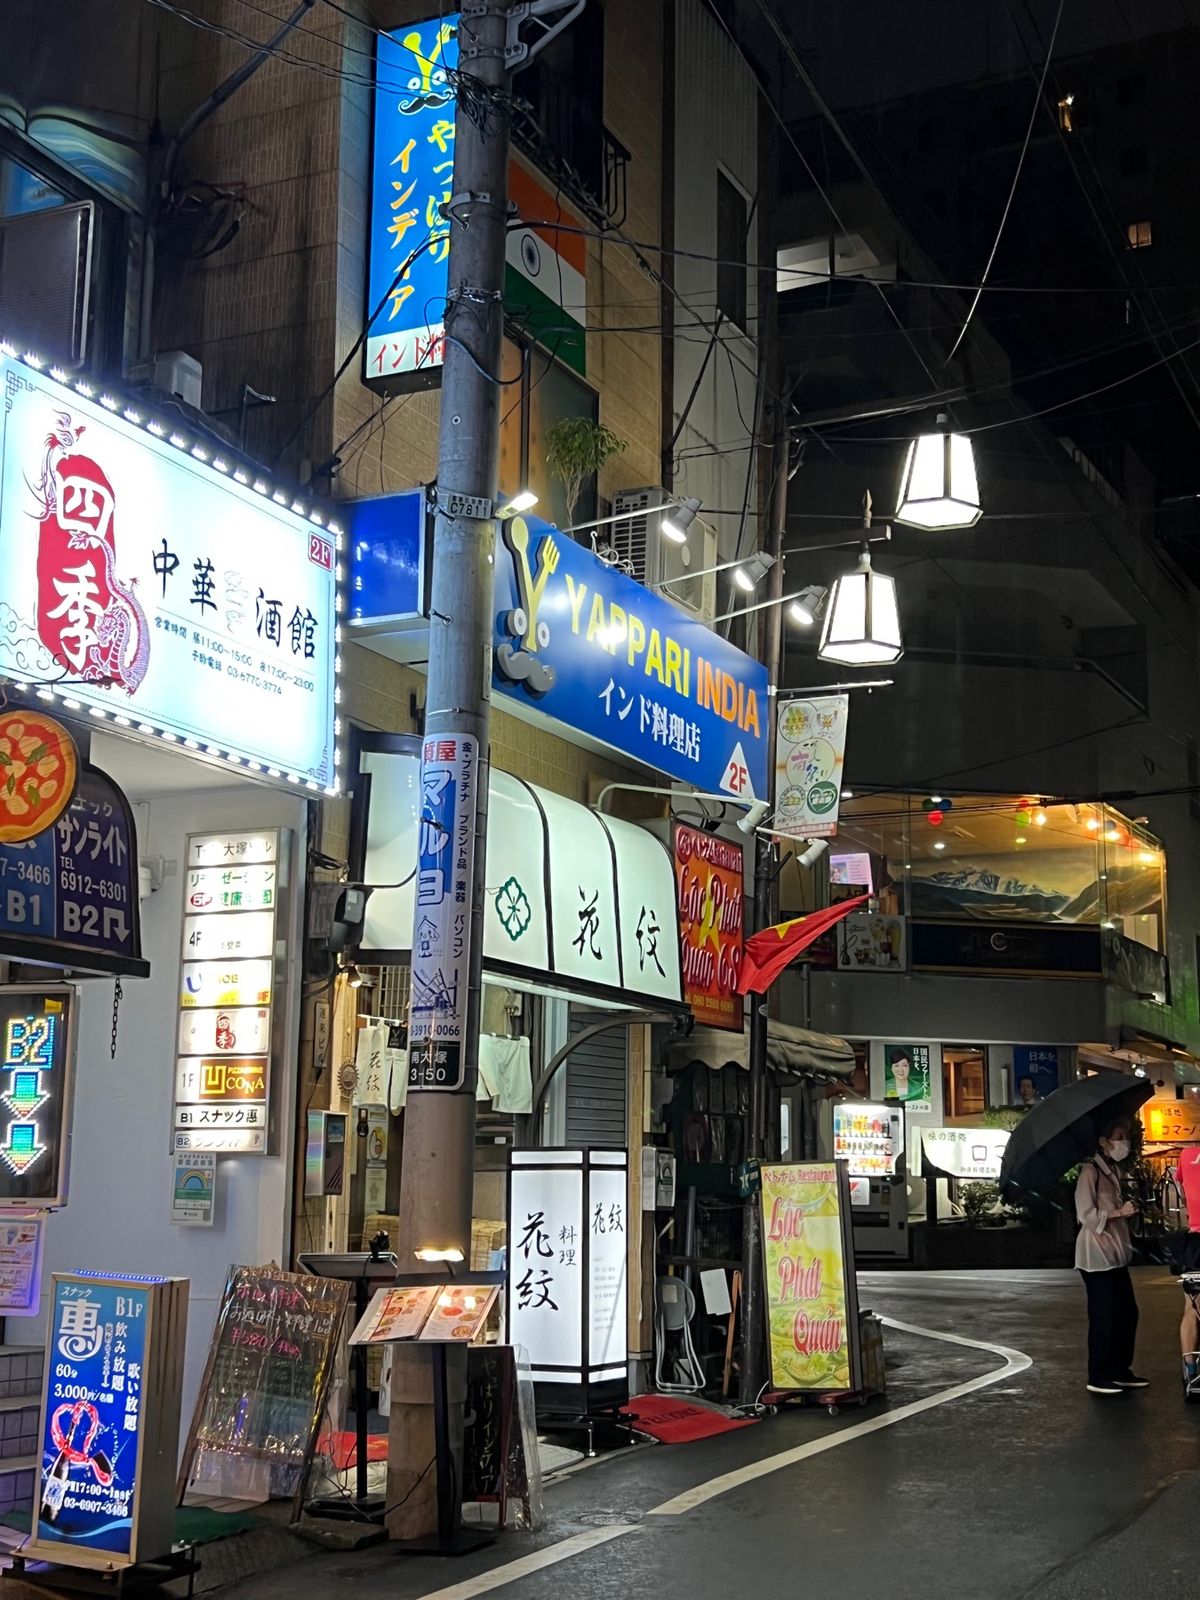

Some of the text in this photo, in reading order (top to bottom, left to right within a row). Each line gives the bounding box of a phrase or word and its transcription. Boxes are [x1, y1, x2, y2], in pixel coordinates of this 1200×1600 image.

[450, 502, 487, 518] C7811
[310, 539, 331, 565] 2F
[47, 475, 114, 671] 四季
[152, 538, 319, 659] 中華 酒館
[565, 573, 760, 737] YAPPARI INDIA
[599, 677, 701, 763] インド料理店
[423, 740, 456, 764] 質屋
[728, 761, 747, 792] 2F
[57, 813, 128, 867] サンライト
[417, 769, 453, 907] マルヨ
[1, 857, 51, 887] 7-3466
[60, 855, 76, 871] TEL
[60, 869, 128, 903] 6912-6301
[455, 881, 467, 903] 楽器
[7, 888, 41, 926] B1
[63, 899, 99, 936] B2
[189, 931, 202, 947] 4F
[453, 914, 465, 959] パソコン
[571, 884, 667, 978] 花紋
[717, 942, 740, 992] 68
[5, 1016, 53, 1067] B2
[411, 1050, 447, 1064] 南大塚
[182, 1073, 265, 1095] 1F CONA
[410, 1068, 447, 1081] 3-50
[180, 1112, 194, 1123] B1
[592, 1202, 624, 1236] 花紋
[515, 1211, 559, 1312] 花紋
[558, 1225, 578, 1266] 料理
[60, 1285, 93, 1298] スナック
[778, 1255, 822, 1305] Phát
[792, 1307, 843, 1358] Quán
[55, 1363, 78, 1379] 60分
[110, 1321, 128, 1392] 飲み放題
[122, 1362, 141, 1432] 歌い放題
